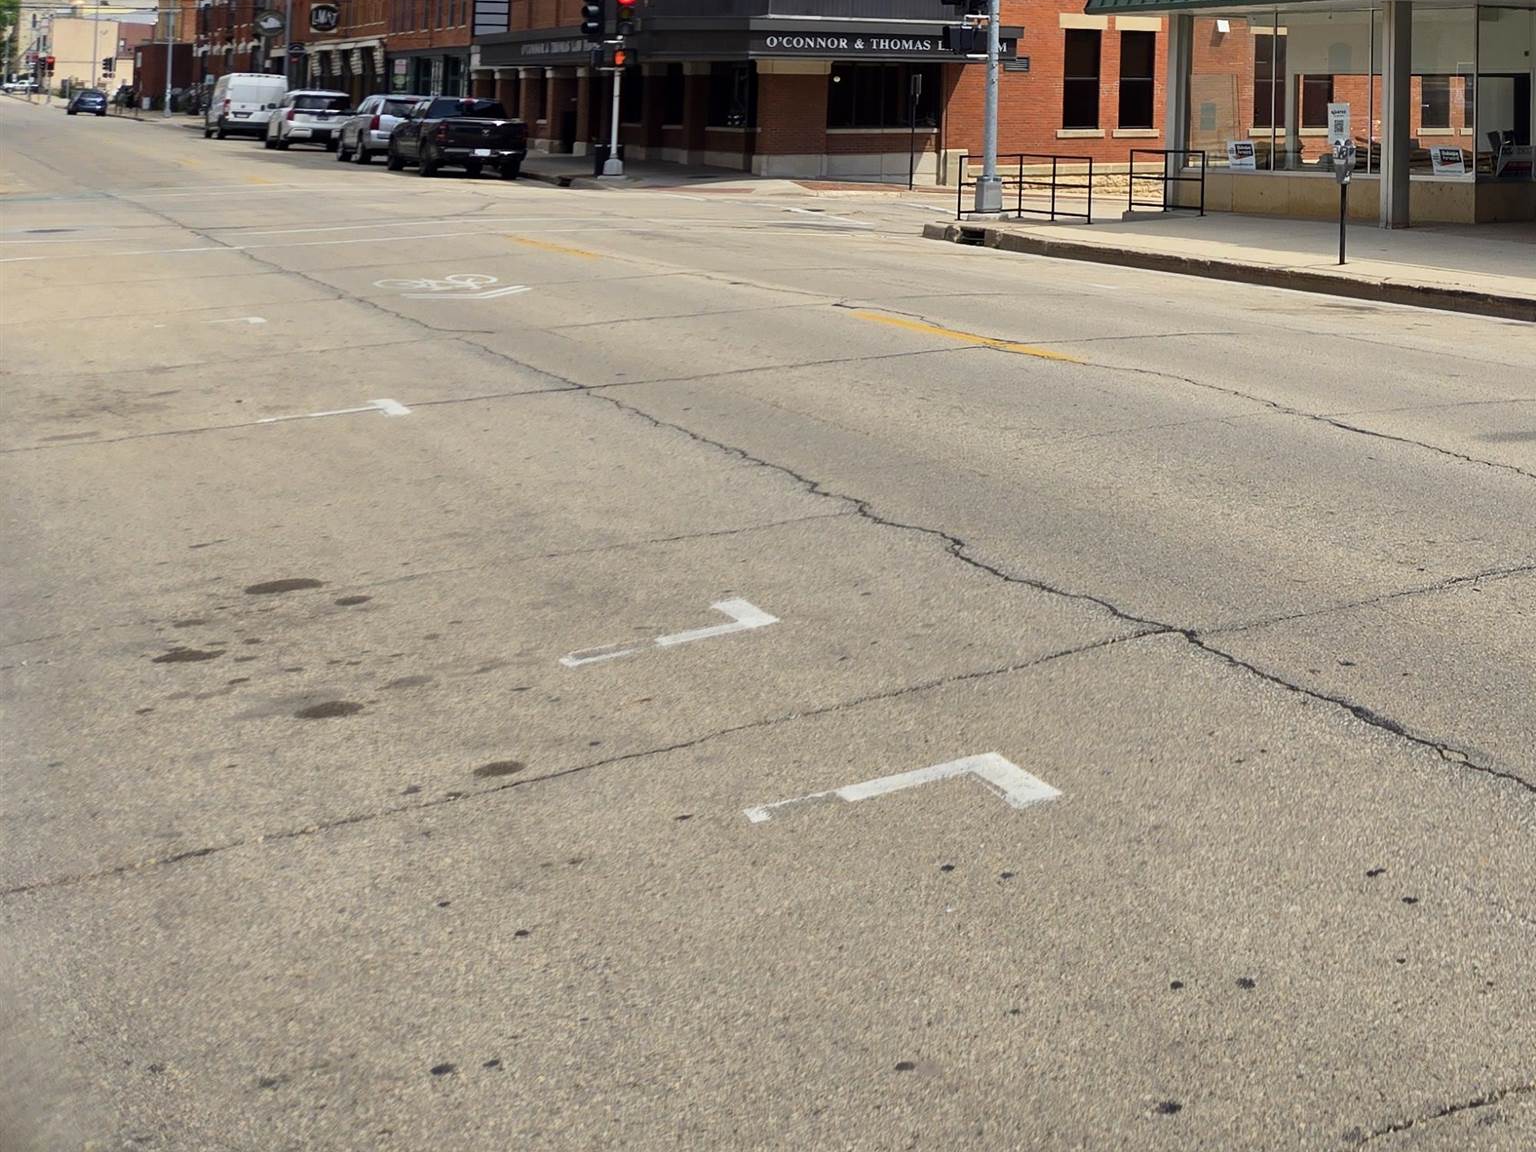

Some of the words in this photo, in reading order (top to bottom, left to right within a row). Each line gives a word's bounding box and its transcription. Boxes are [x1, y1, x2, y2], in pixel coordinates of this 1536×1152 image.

[766, 36, 848, 49] O'CONNOR
[854, 38, 865, 50] &
[870, 38, 931, 51] THOMAS
